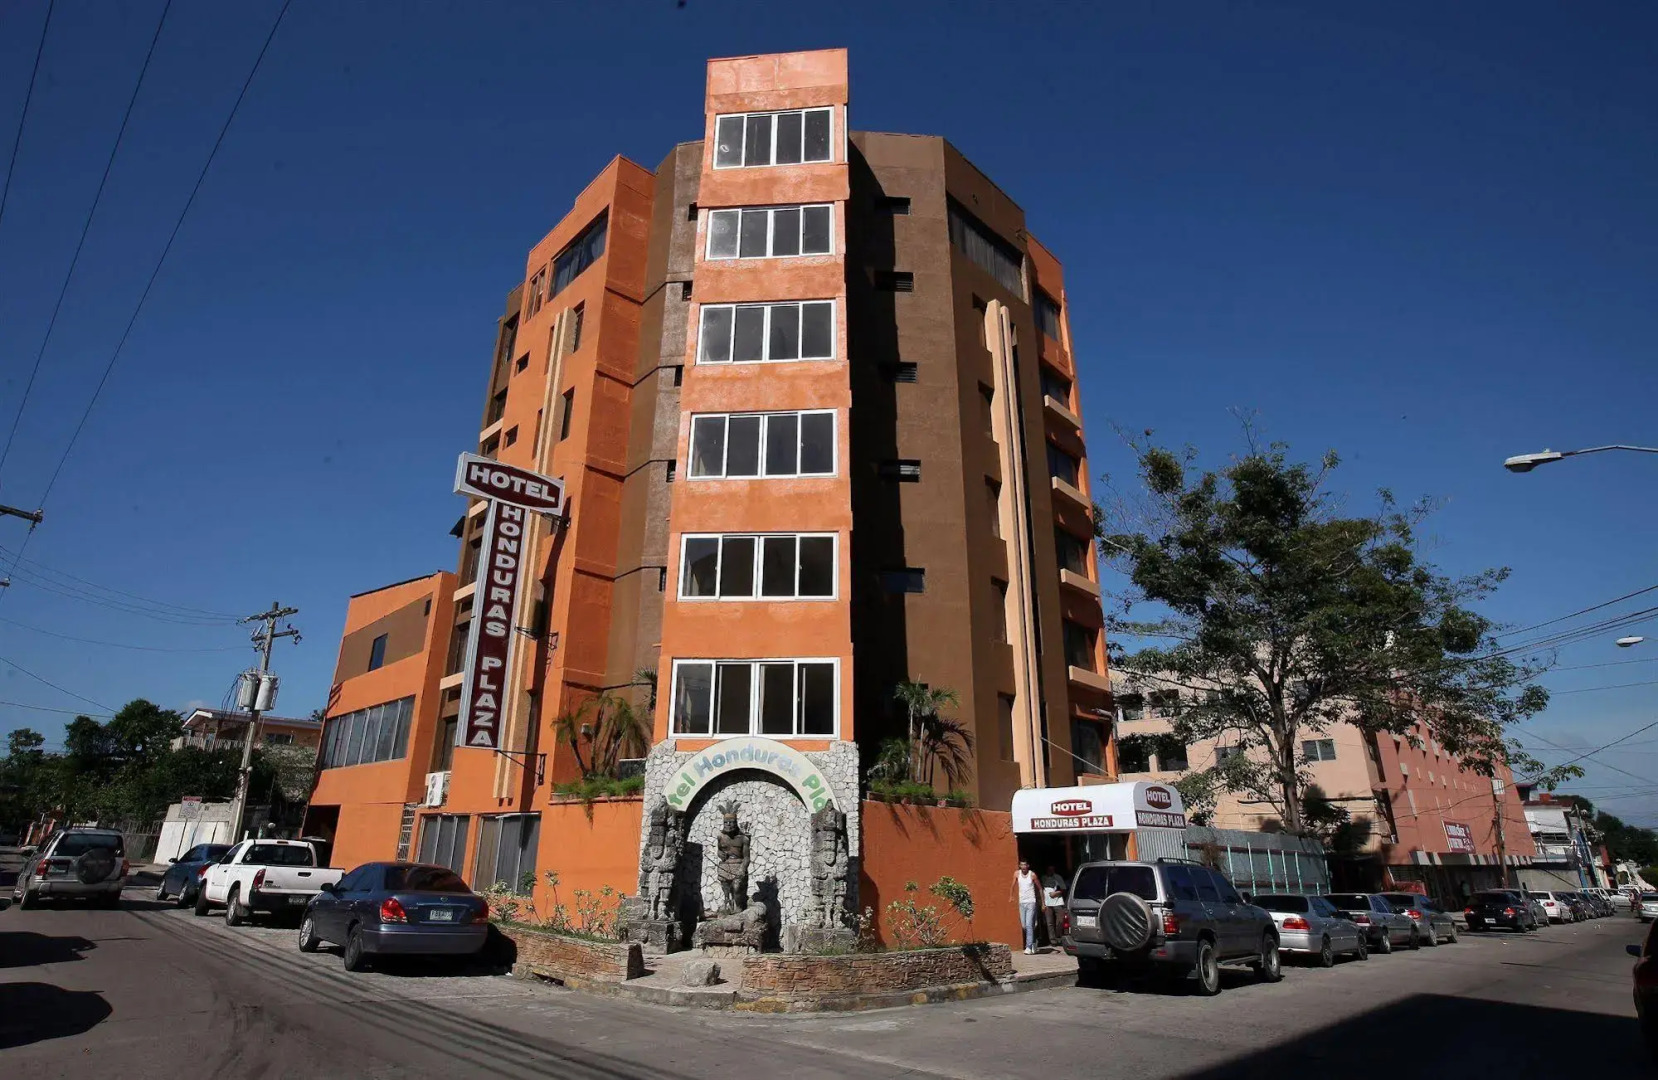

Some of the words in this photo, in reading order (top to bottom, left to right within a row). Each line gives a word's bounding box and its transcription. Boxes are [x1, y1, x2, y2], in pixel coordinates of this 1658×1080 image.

[470, 465, 555, 502] HOTEL
[485, 504, 521, 637] HONDURAS
[471, 656, 502, 747] PLAZA
[668, 772, 696, 807] tel
[1147, 790, 1170, 803] HOTEL
[1053, 803, 1090, 811] HOTEL
[1137, 812, 1167, 826] HONDURAS
[1168, 814, 1184, 827] PLAZA
[1034, 818, 1080, 829] HONDURAS
[1081, 816, 1110, 827] PLAZA
